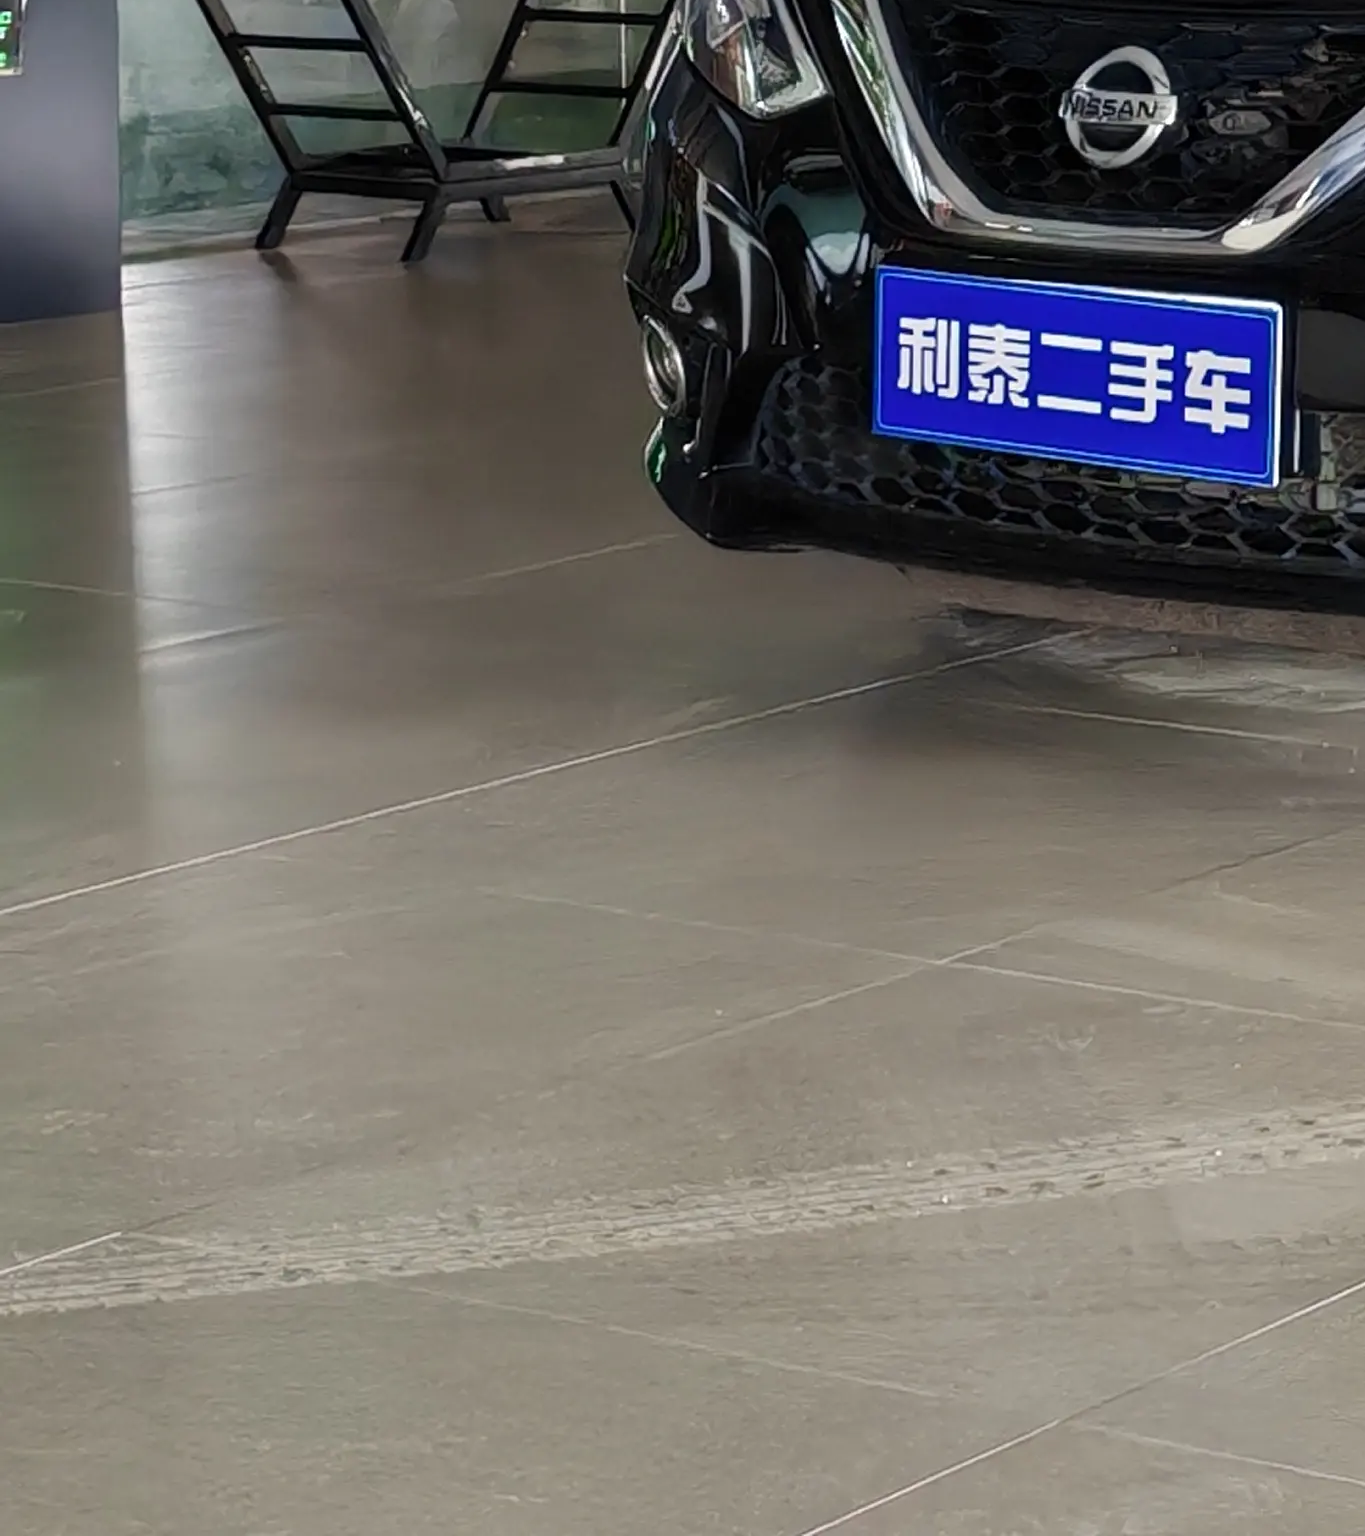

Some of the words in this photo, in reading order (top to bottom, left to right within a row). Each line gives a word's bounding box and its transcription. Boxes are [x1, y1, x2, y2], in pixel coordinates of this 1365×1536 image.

[897, 316, 1252, 435] 利泰二手车
